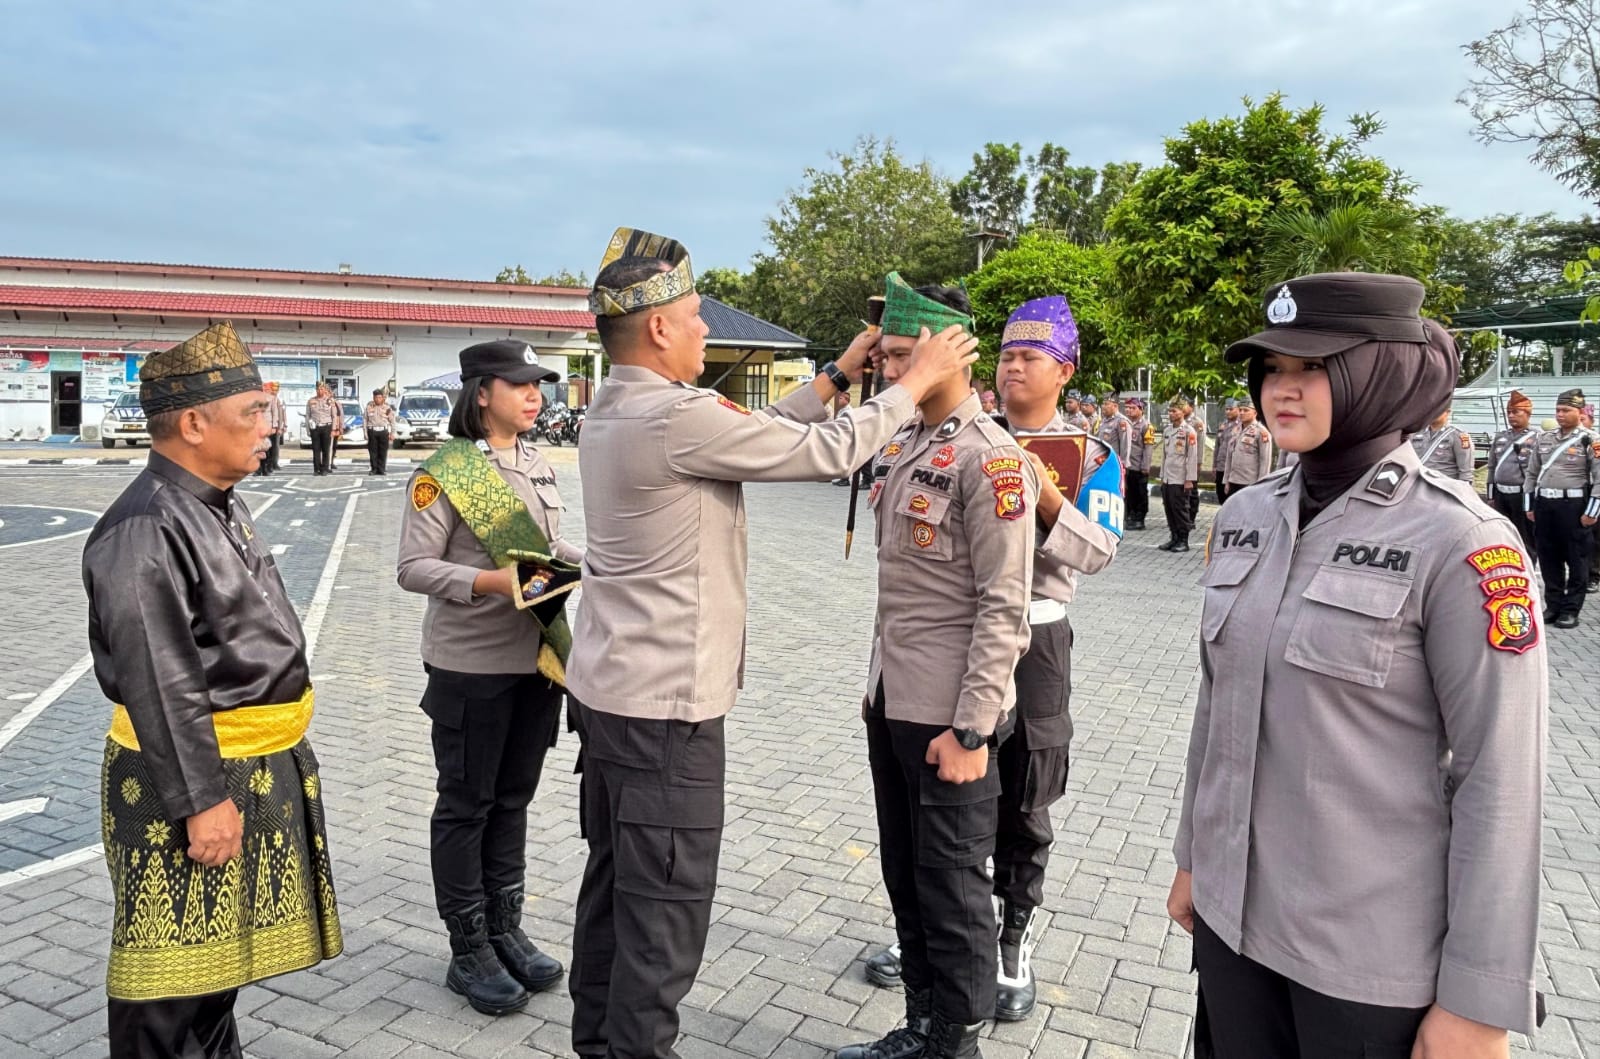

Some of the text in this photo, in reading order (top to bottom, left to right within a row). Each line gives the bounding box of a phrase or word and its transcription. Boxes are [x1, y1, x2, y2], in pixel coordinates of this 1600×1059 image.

[911, 469, 952, 491] POLRI
[997, 477, 1020, 487] RIAU
[1220, 529, 1259, 549] TIA
[1332, 542, 1412, 573] POLRI
[1473, 547, 1521, 565] POLRES
[1488, 577, 1526, 591] RIAU
